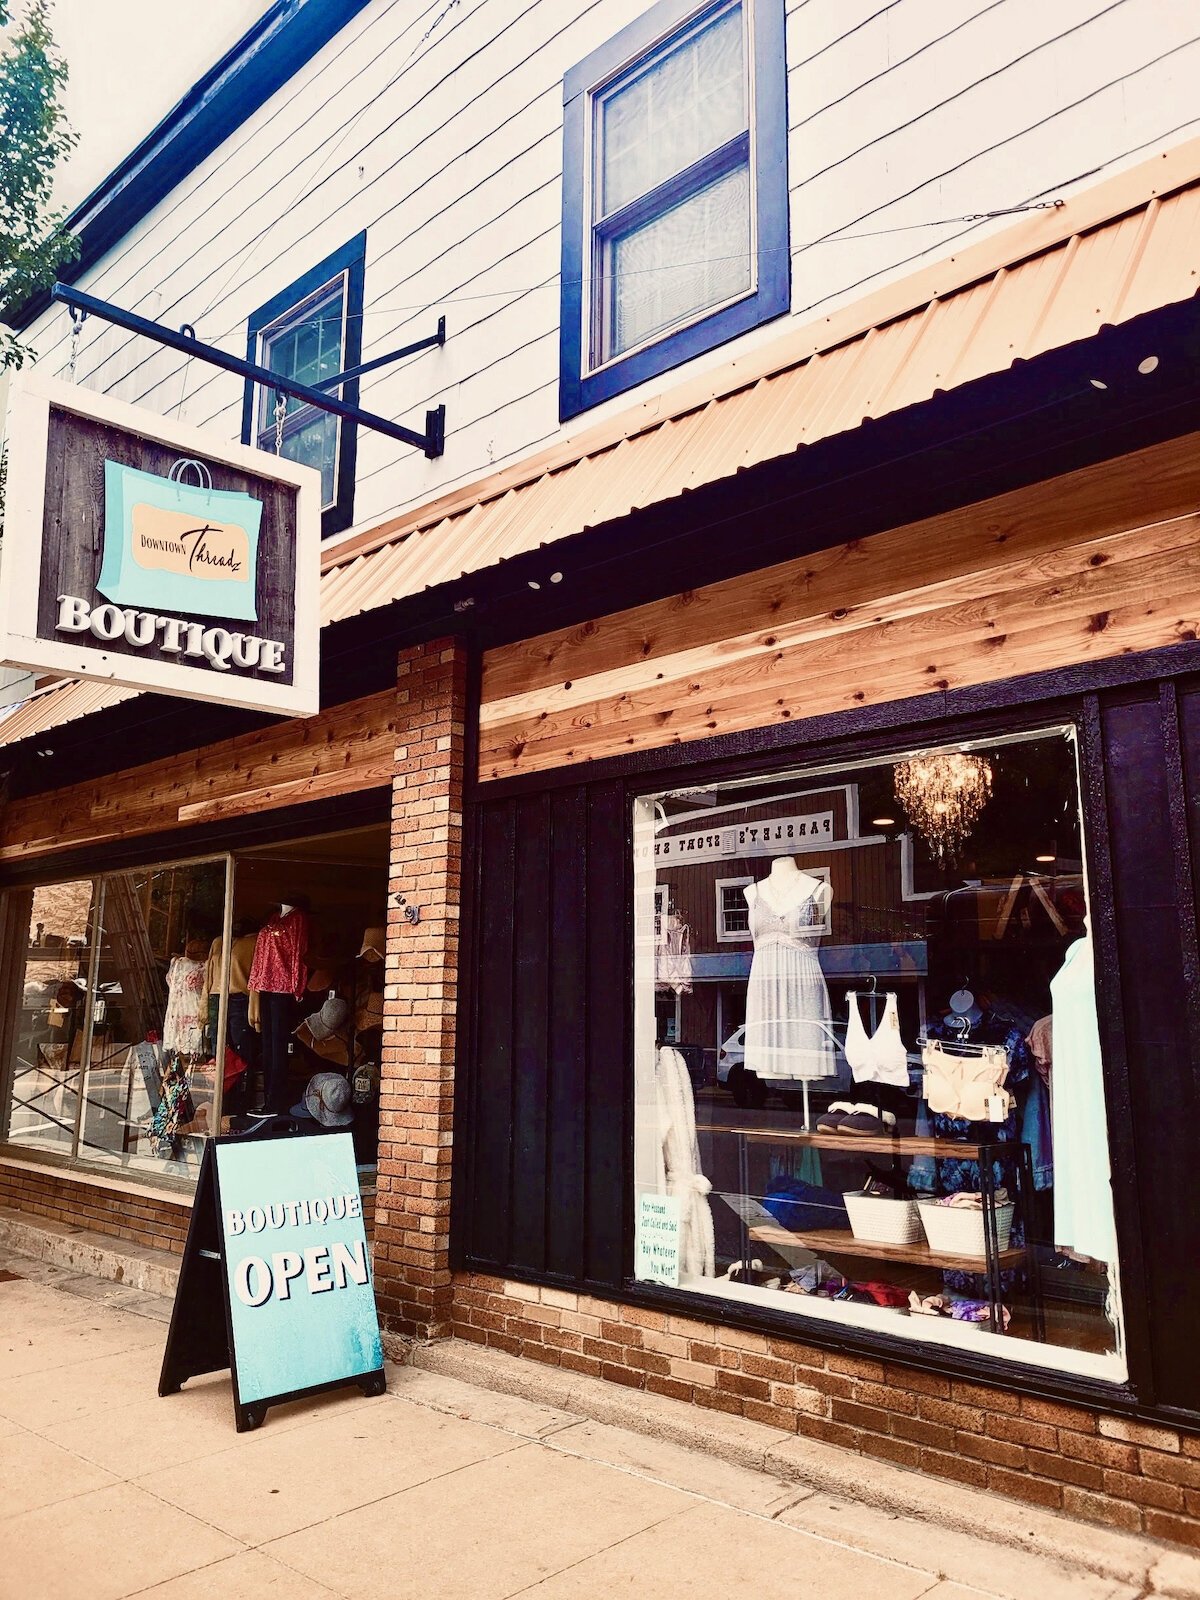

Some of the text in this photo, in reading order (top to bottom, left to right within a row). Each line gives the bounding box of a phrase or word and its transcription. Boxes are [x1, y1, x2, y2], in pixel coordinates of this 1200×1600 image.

[55, 594, 286, 674] BOUTIQUE
[226, 1193, 361, 1236] BOUTIQUE
[234, 1239, 370, 1307] OPEN
[653, 1242, 676, 1258] Whatever
